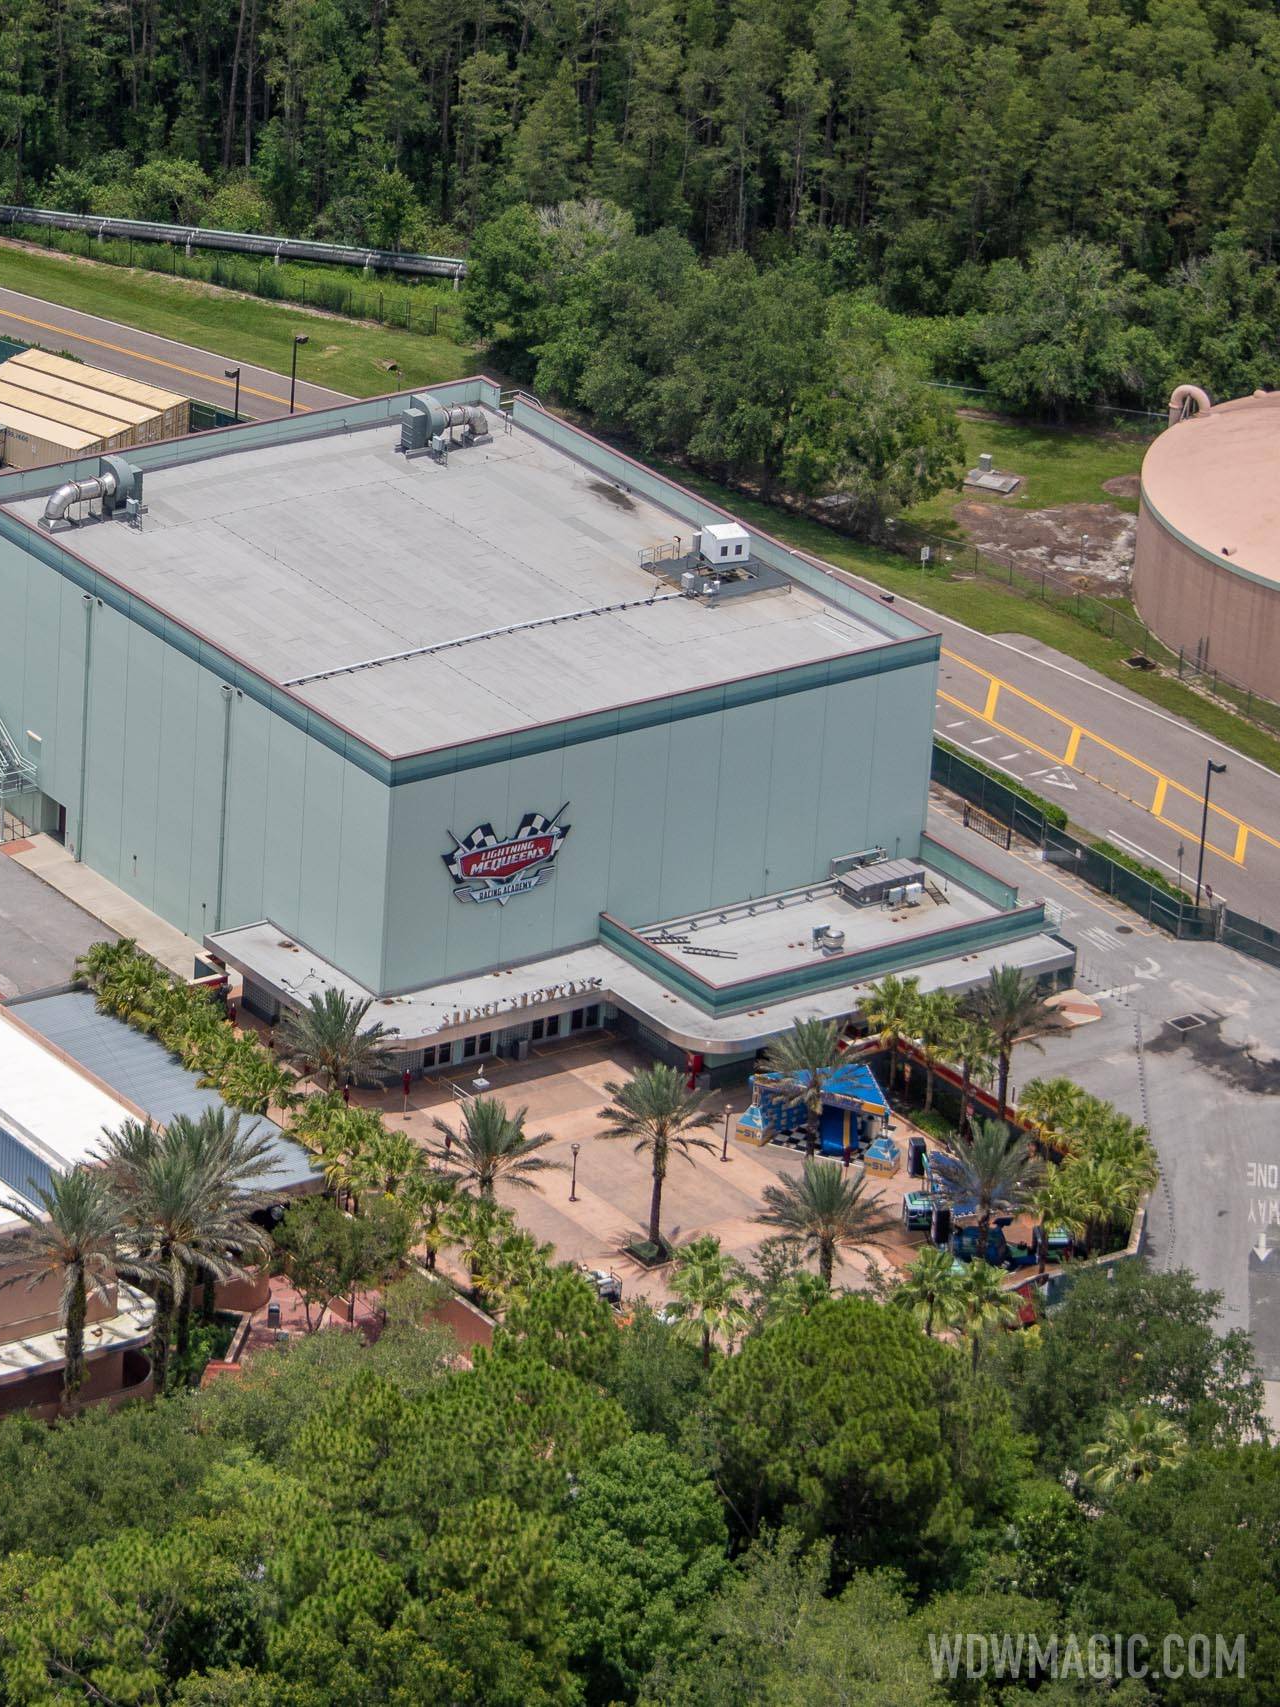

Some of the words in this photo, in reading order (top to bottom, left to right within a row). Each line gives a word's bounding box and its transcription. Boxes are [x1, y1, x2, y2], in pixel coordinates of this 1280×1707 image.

[481, 840, 534, 861] LIGHTNING
[479, 887, 502, 900] RACING
[503, 880, 532, 895] ACADEMY
[442, 1001, 499, 1026] SUNSET
[510, 976, 601, 1009] SHOWCASE
[1246, 1162, 1278, 1189] ONE
[1247, 1198, 1280, 1225] WAY
